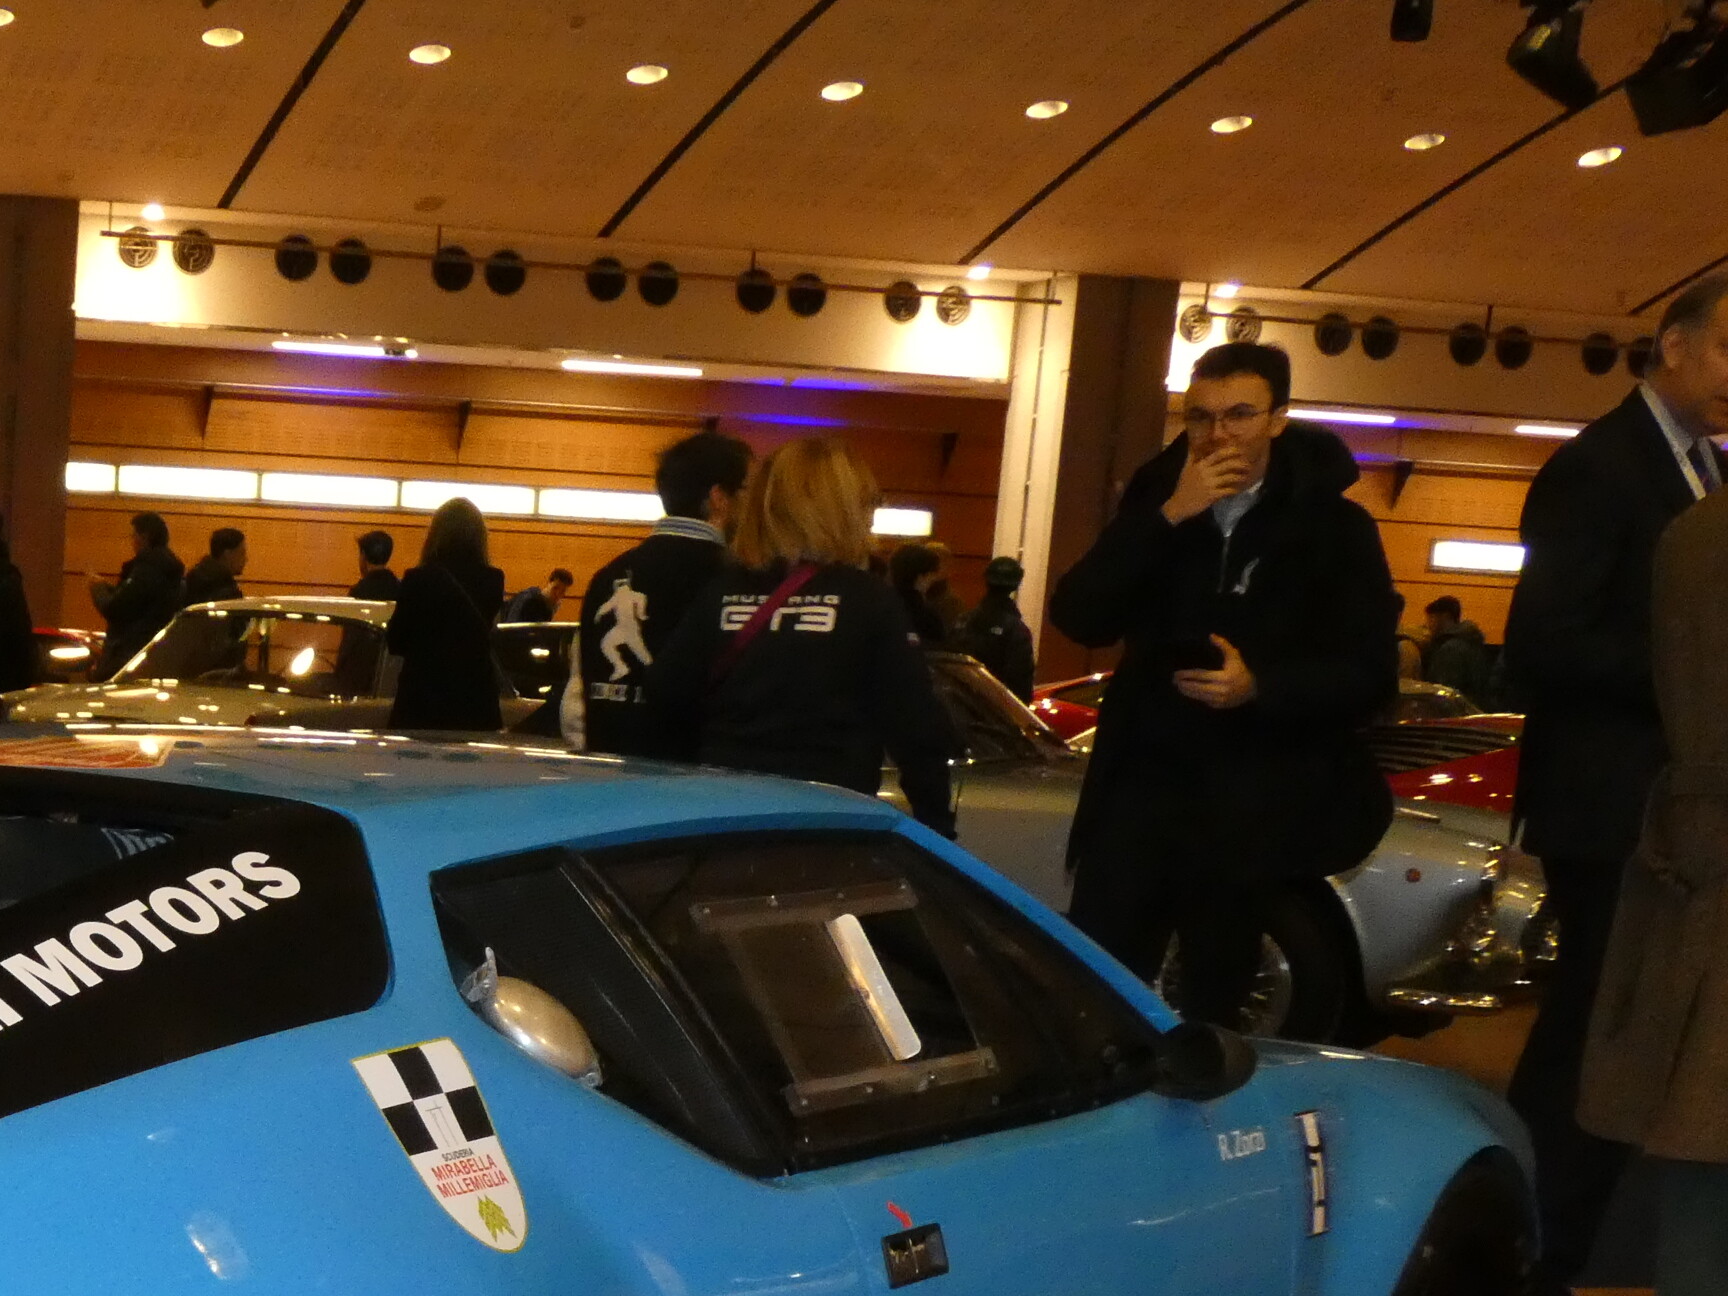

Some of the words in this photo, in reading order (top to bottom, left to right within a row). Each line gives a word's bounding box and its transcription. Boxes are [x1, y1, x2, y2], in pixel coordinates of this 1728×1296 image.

[721, 594, 841, 606] MUSANG
[0, 850, 302, 1007] MOTORS
[431, 1154, 498, 1182] MIRABELLA
[441, 1147, 475, 1162] SCUDERIA
[436, 1169, 509, 1198] MILLEMIGLIA
